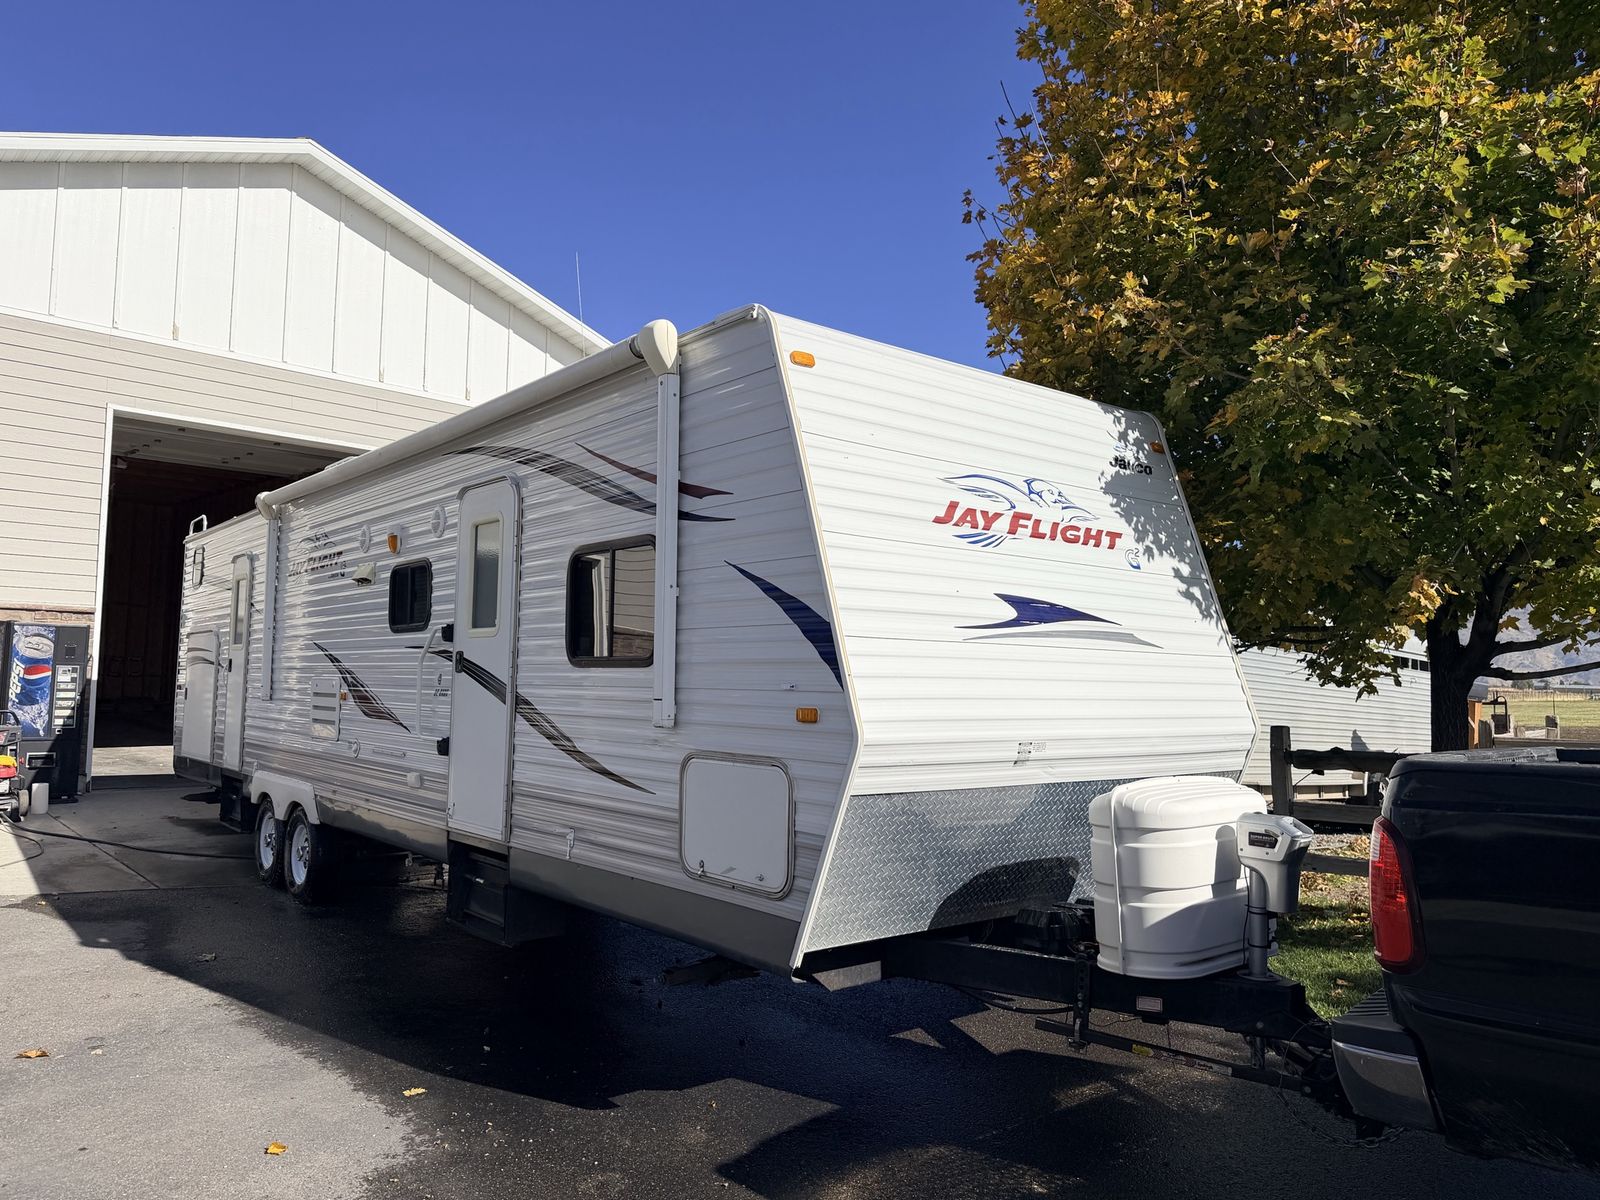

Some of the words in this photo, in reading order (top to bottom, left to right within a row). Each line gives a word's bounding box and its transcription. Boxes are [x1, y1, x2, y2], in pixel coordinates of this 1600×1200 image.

[932, 500, 1004, 531] JAY
[1007, 511, 1123, 550] FLIGHT
[9, 657, 25, 703] PEPSI
